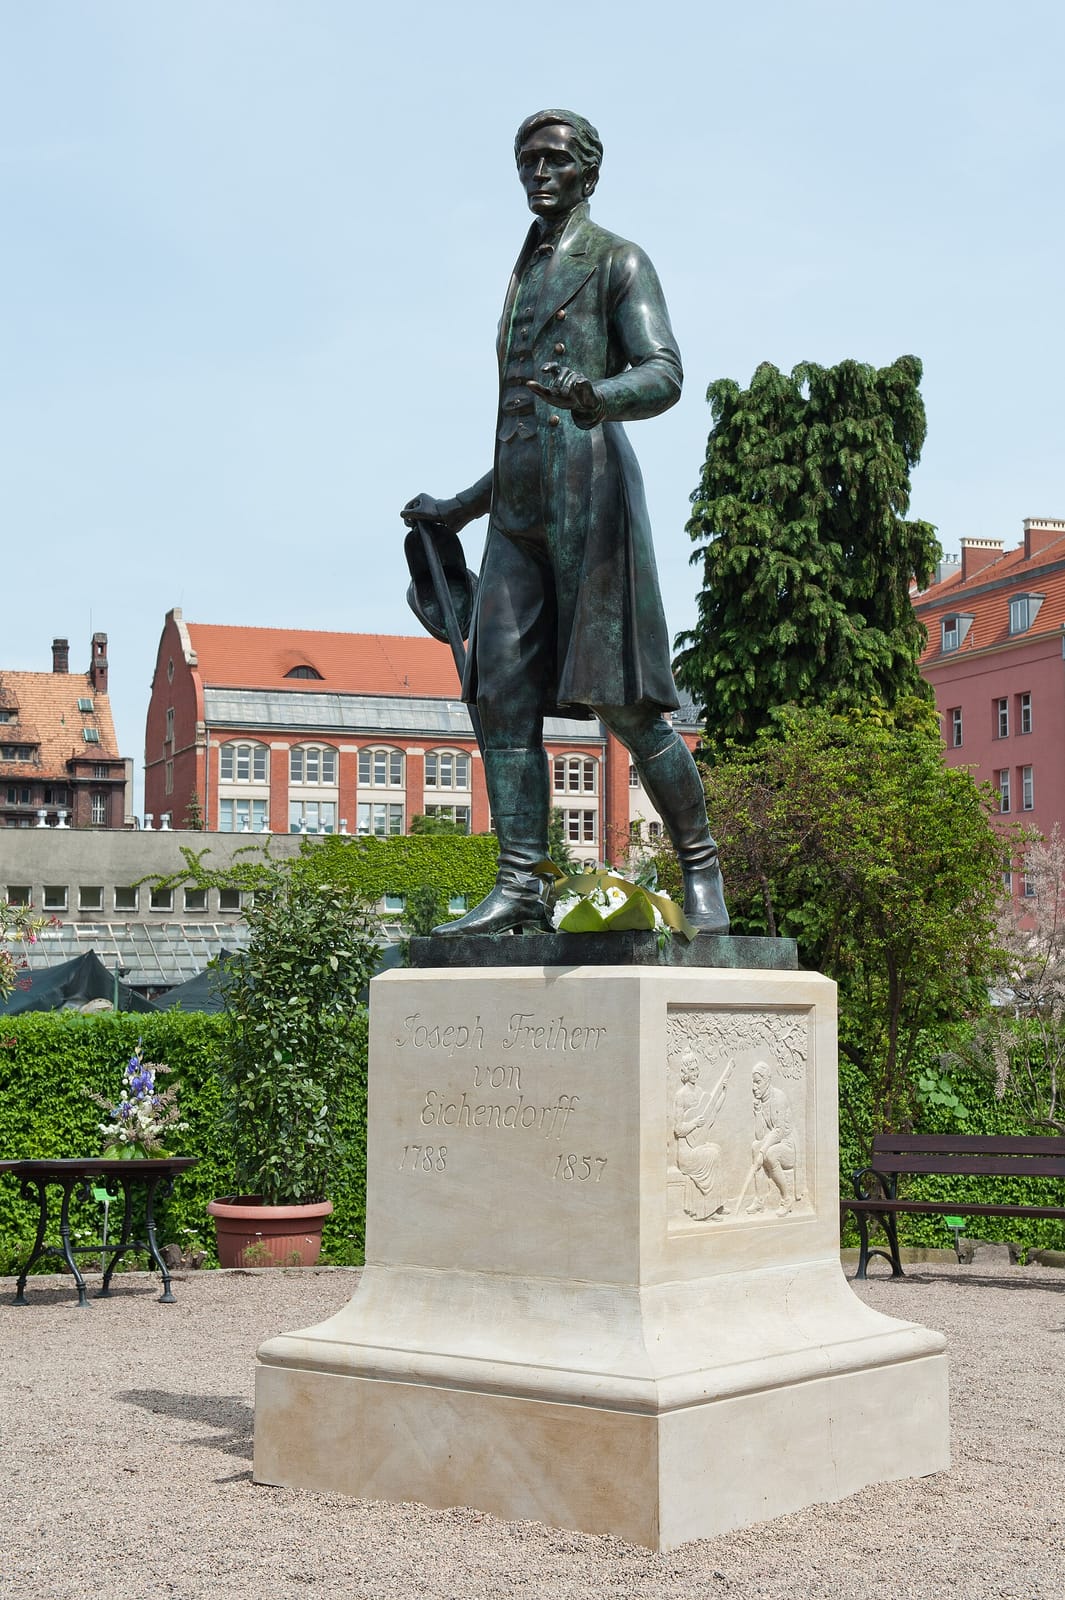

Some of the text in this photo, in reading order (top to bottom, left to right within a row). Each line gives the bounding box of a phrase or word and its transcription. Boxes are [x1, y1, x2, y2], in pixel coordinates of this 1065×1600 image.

[396, 1013, 607, 1057] Joseph Freiherr
[473, 1065, 521, 1090] von
[420, 1090, 580, 1141] Eichendorff
[399, 1145, 608, 1182] 1788 1857
